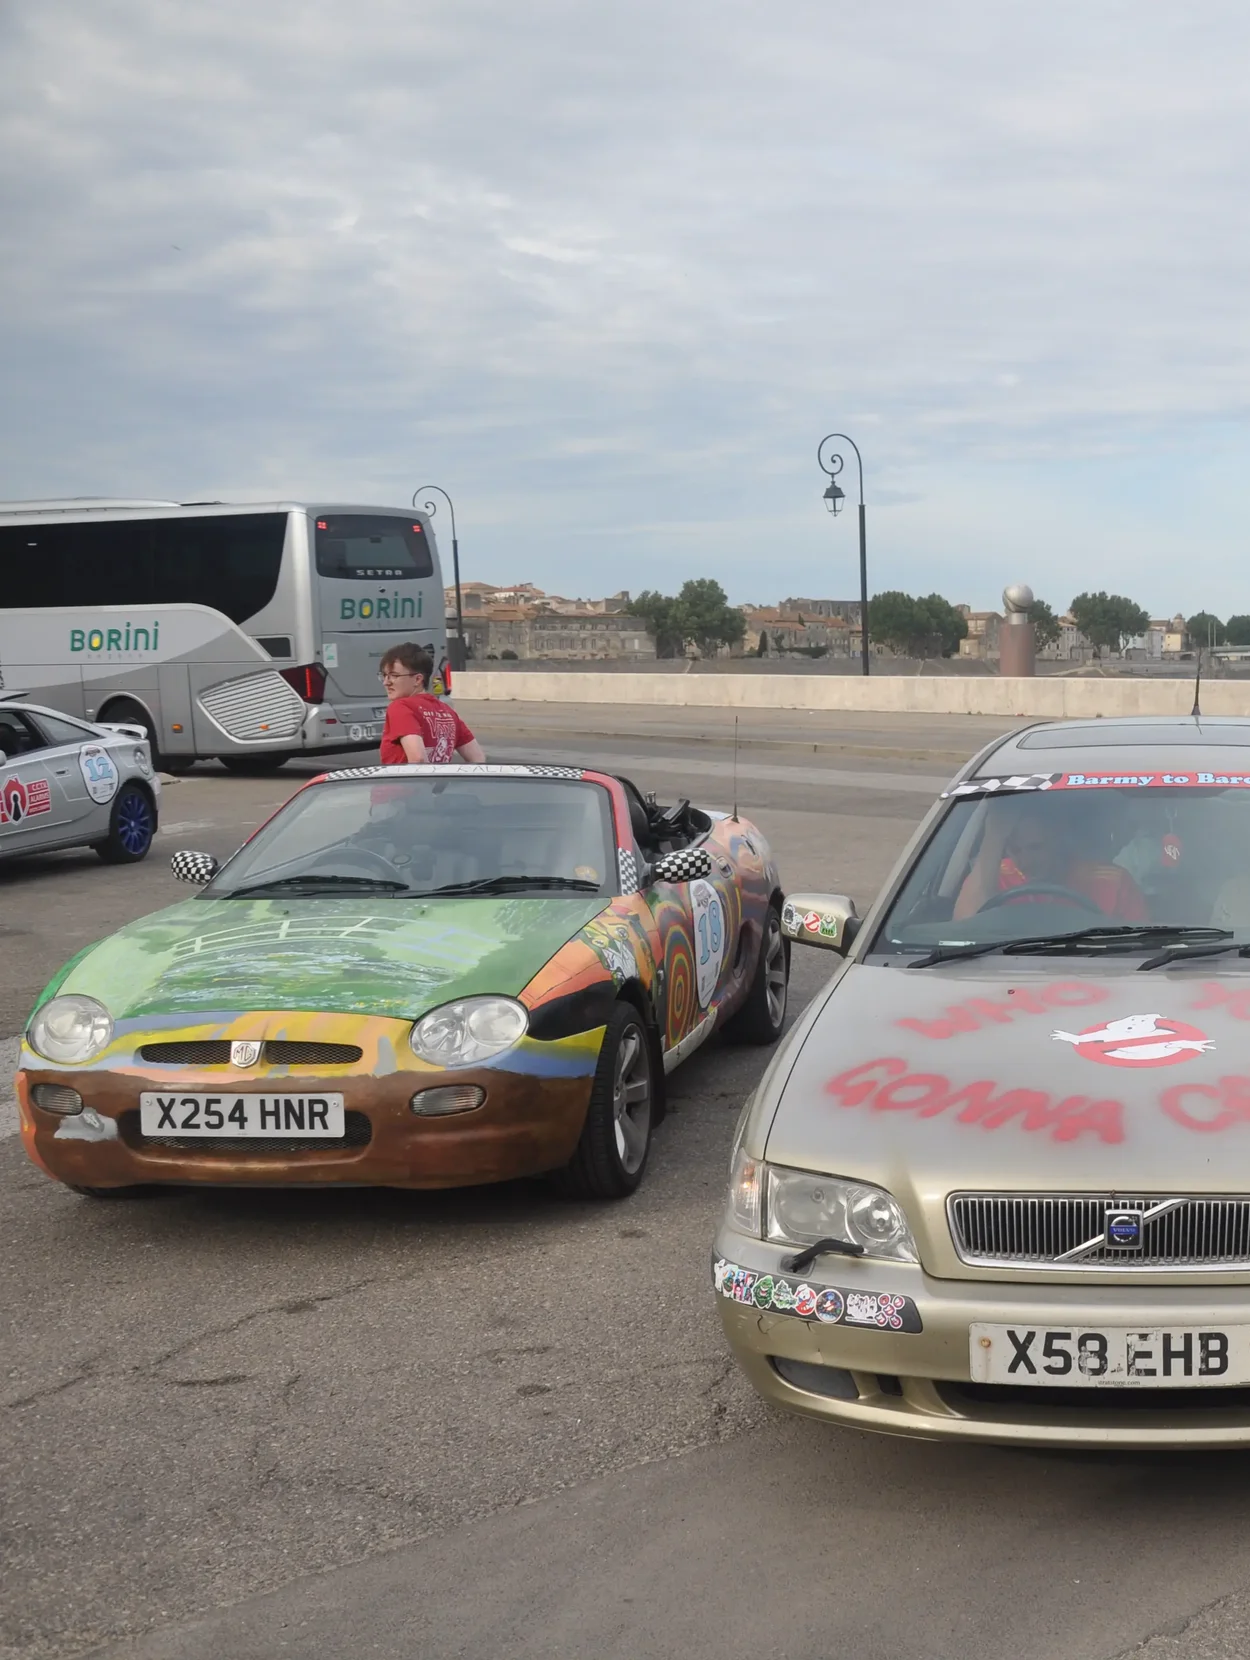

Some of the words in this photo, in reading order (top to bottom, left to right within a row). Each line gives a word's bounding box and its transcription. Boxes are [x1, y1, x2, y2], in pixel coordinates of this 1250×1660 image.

[85, 756, 113, 781] 12
[1067, 773, 1155, 786] Barmy
[1162, 773, 1190, 784] to
[698, 900, 721, 965] 18
[893, 980, 1109, 1040] WHO
[234, 1045, 255, 1062] MG
[156, 1097, 248, 1130] X254
[260, 1098, 329, 1130] HNR
[823, 1056, 1126, 1145] GONNA
[1006, 1330, 1108, 1376] X58
[1126, 1331, 1229, 1377] EHB
